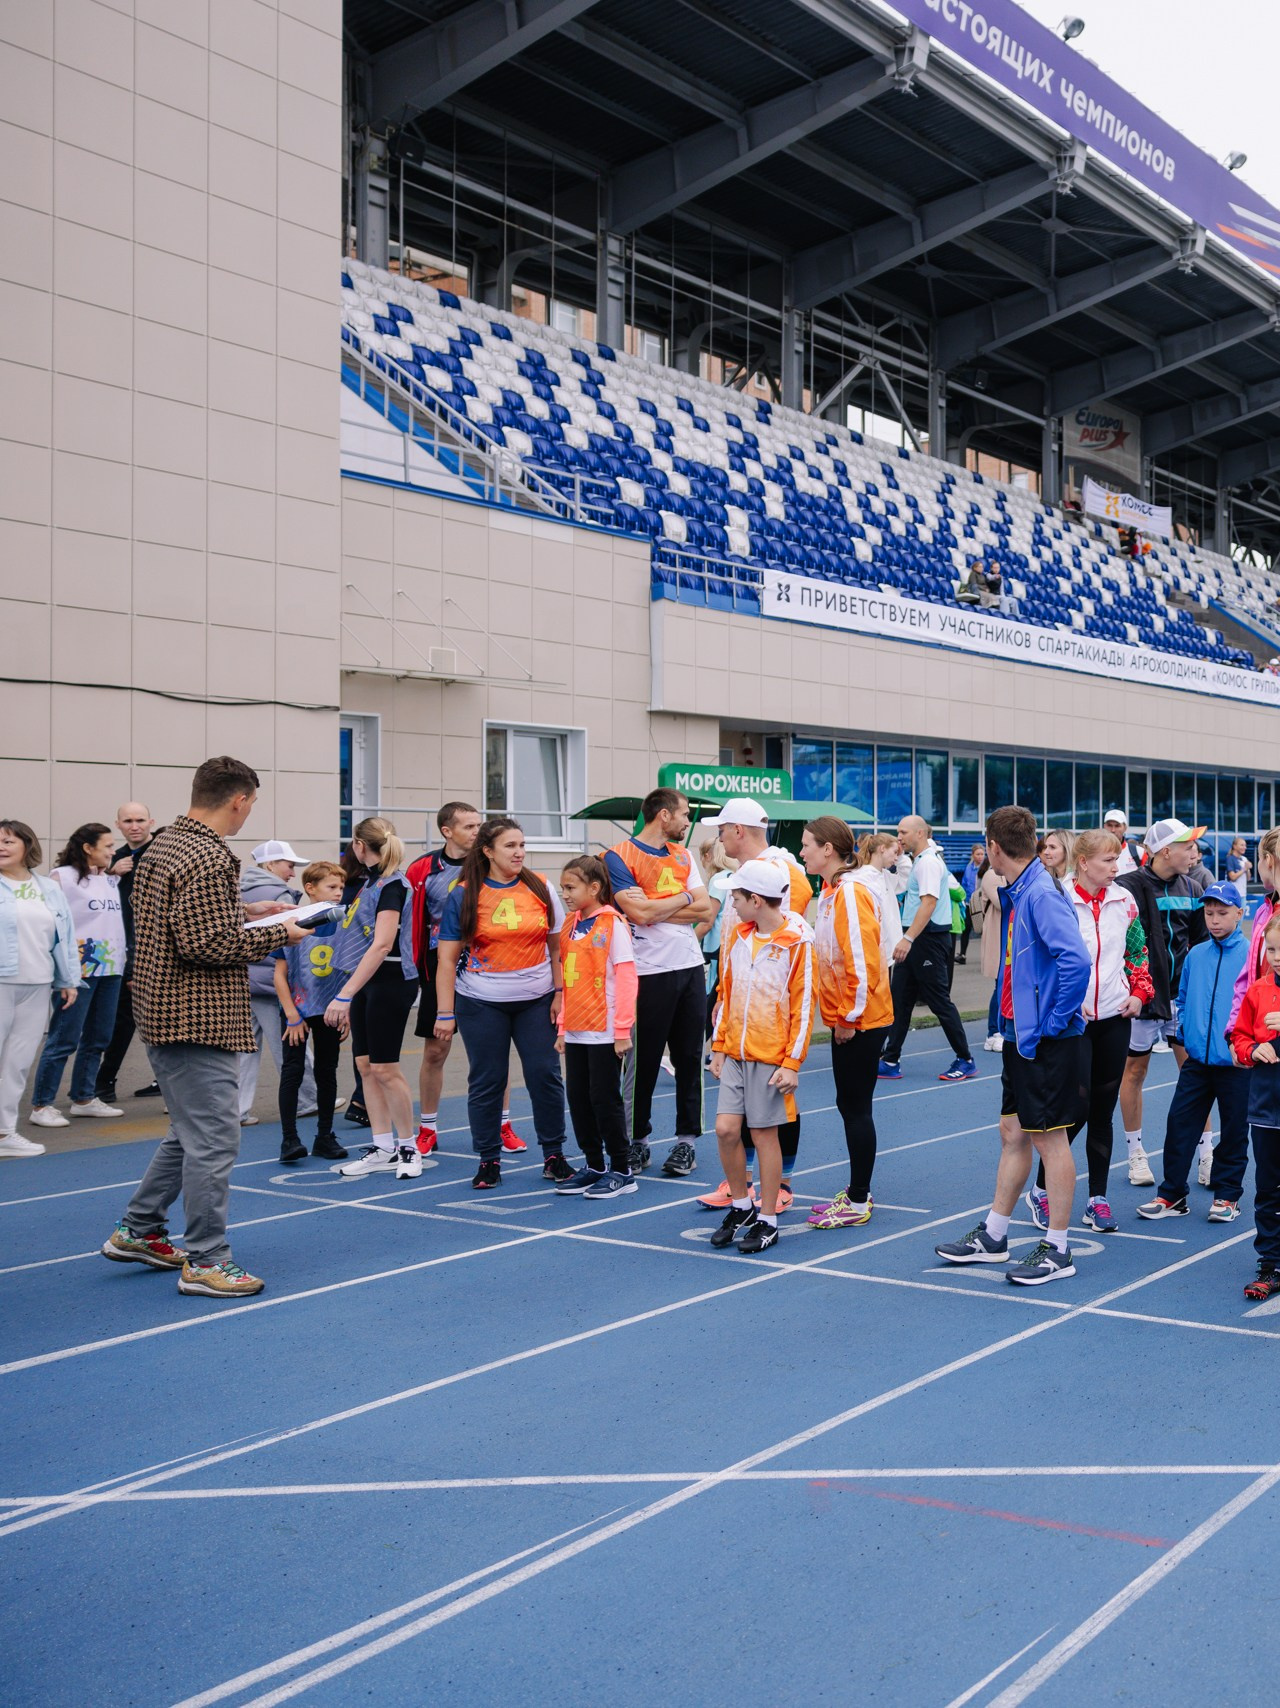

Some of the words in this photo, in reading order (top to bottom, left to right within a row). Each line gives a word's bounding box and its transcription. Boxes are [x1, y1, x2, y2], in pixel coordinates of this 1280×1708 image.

[1060, 77, 1175, 182] чемпионов
[800, 586, 931, 629] ПРИВЕТСТВУЕМ
[939, 614, 1032, 649] УЧАСТНИКОВ
[1037, 635, 1126, 668] СПАРТАКИАДЫ
[1130, 653, 1208, 682] АГРОХОЛДИНГА
[1211, 671, 1248, 690] «КОМОС
[1251, 680, 1280, 695] ГРУПП»
[675, 771, 782, 795] МОРОЖЕНОЕ
[656, 866, 684, 895] 4
[88, 899, 121, 911] СУДЬ
[491, 898, 523, 931] 4
[309, 944, 335, 978] 9
